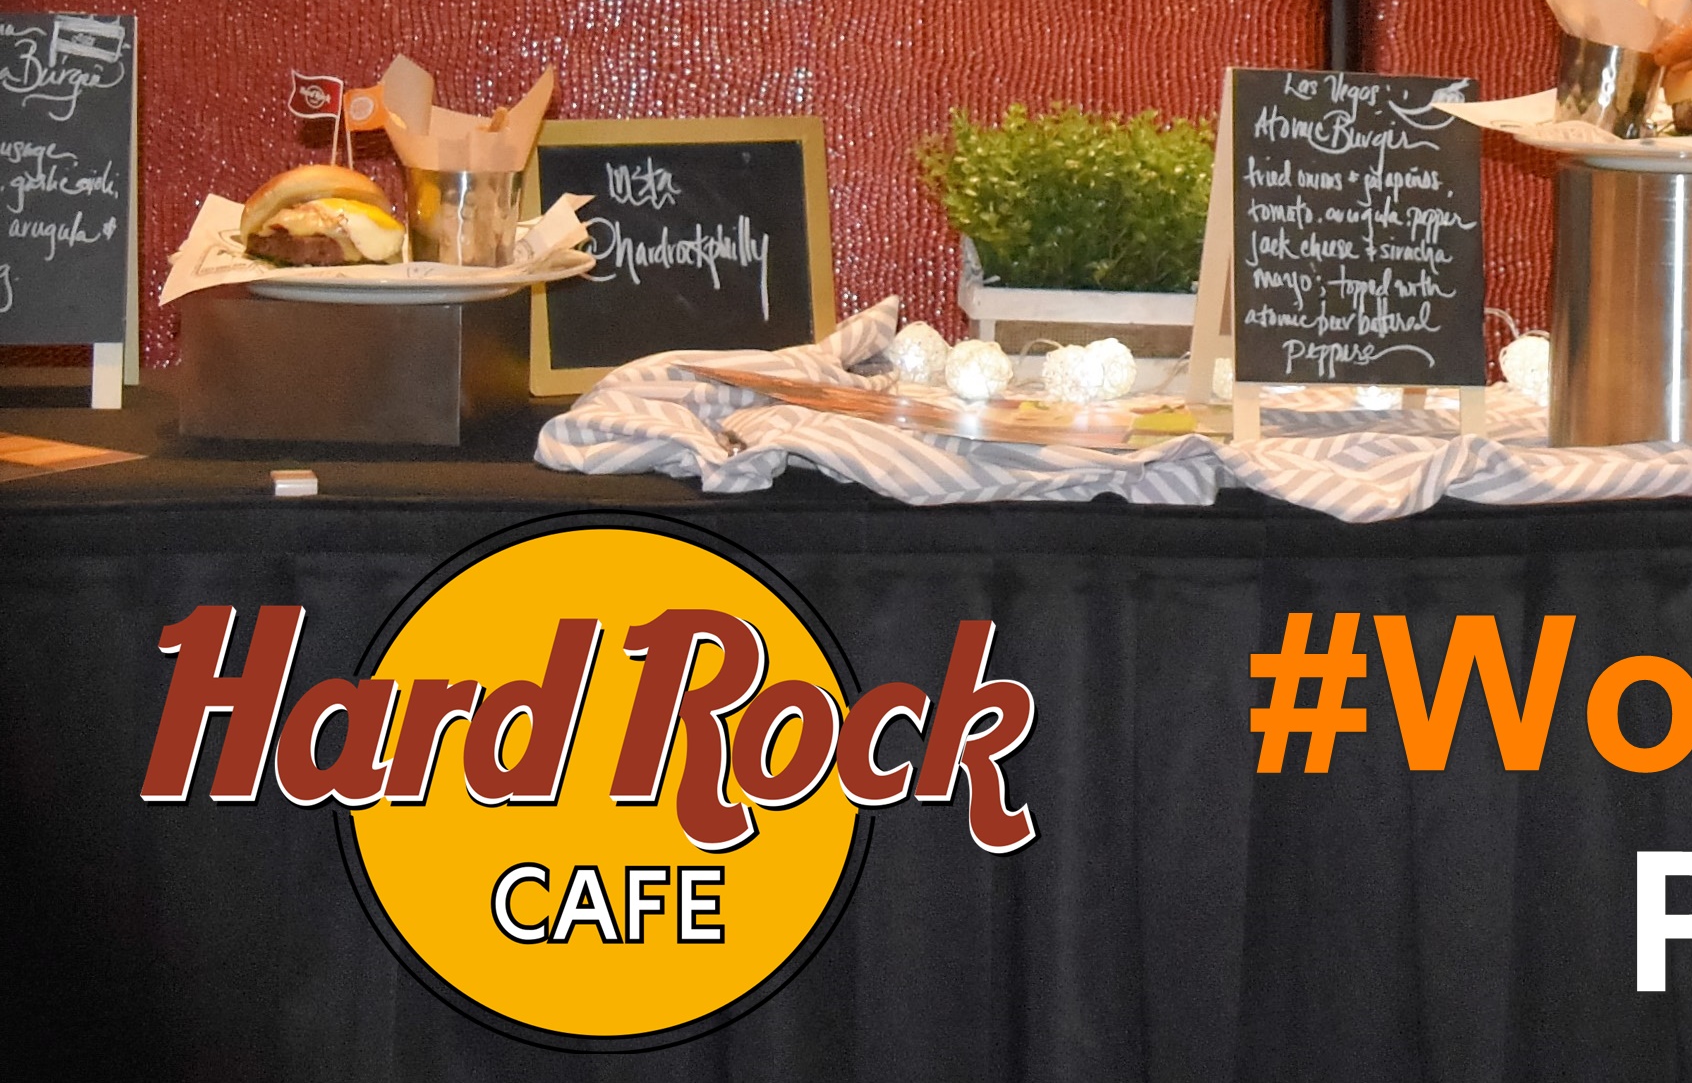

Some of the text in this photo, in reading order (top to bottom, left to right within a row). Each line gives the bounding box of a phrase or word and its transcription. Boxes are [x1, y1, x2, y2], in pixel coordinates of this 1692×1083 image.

[1285, 73, 1317, 100] Las
[1255, 105, 1329, 141] Atomic
[9, 211, 100, 261] arugula
